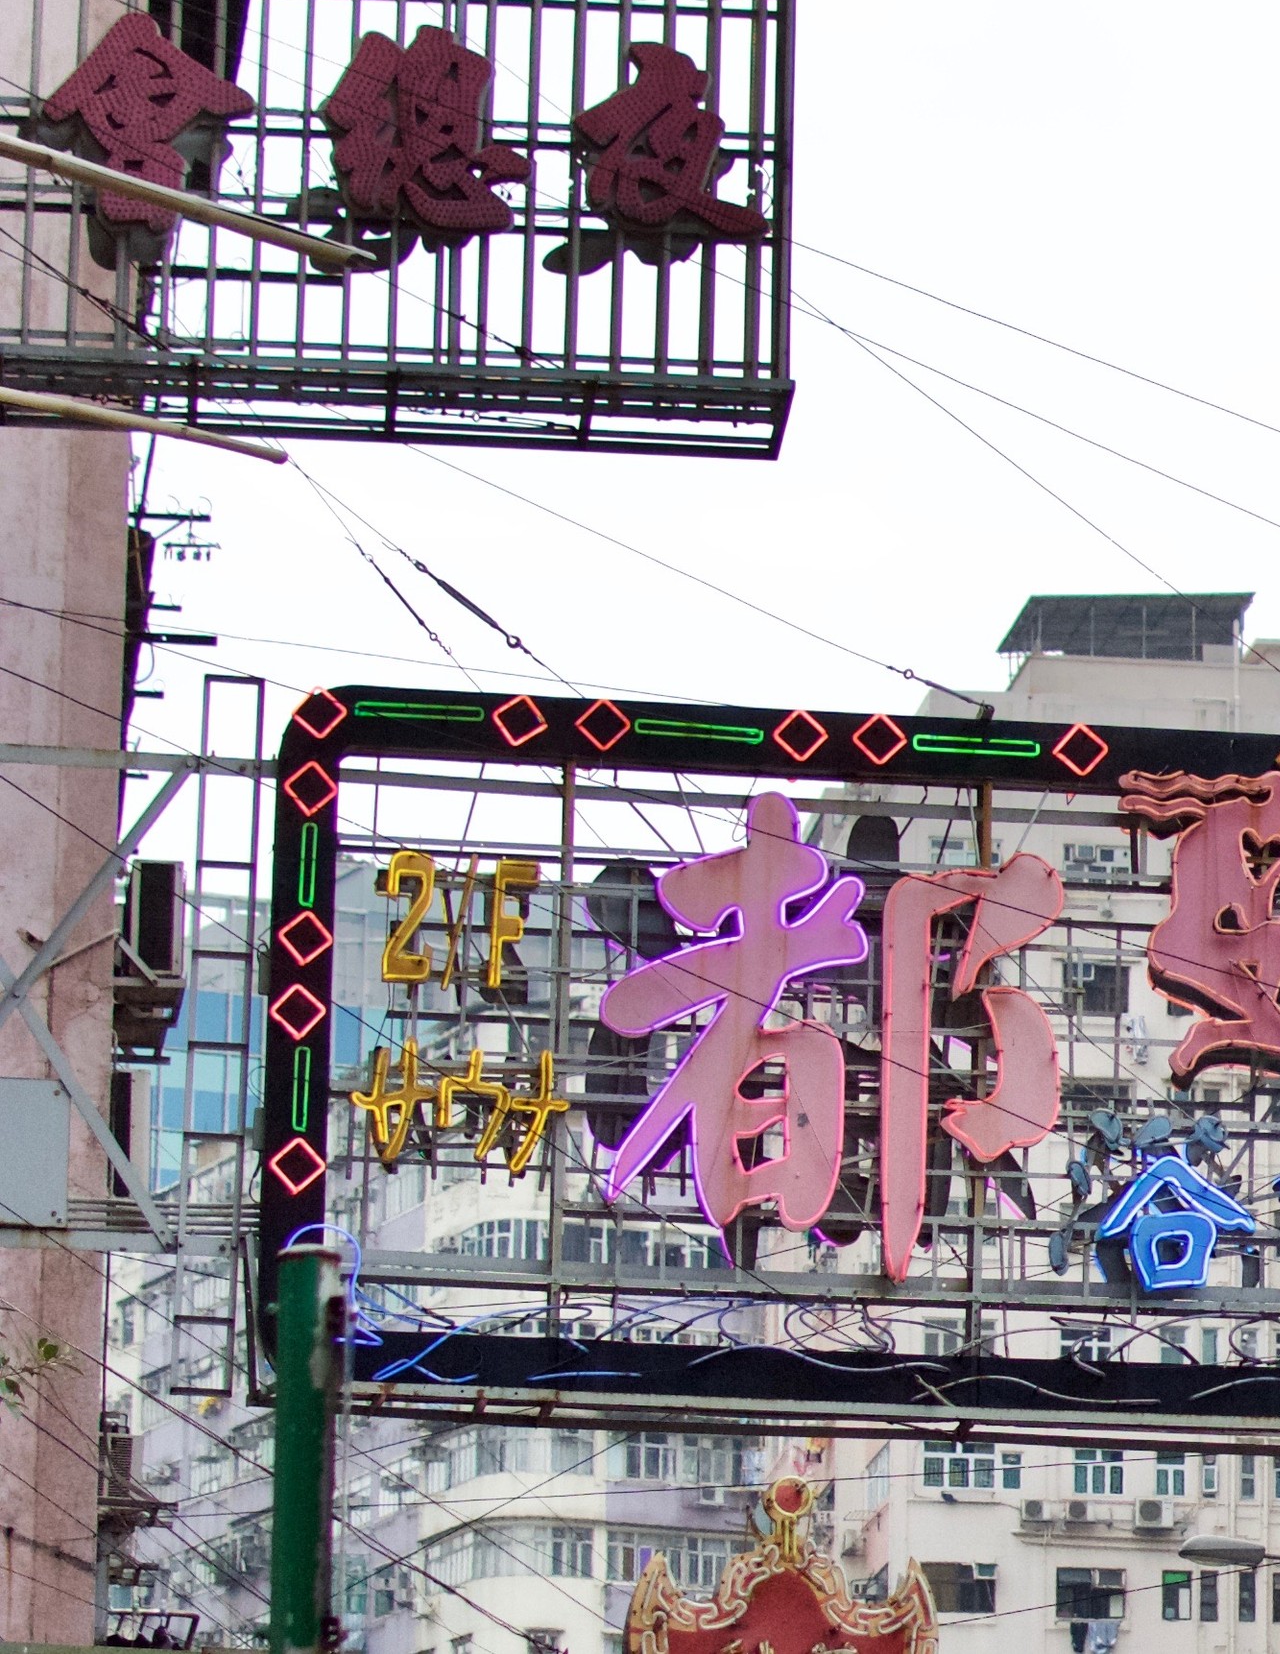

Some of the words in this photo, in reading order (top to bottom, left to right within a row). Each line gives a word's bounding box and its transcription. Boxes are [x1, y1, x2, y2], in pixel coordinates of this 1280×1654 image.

[380, 849, 542, 991] 2/F
[350, 1038, 570, 1175] サウナ
